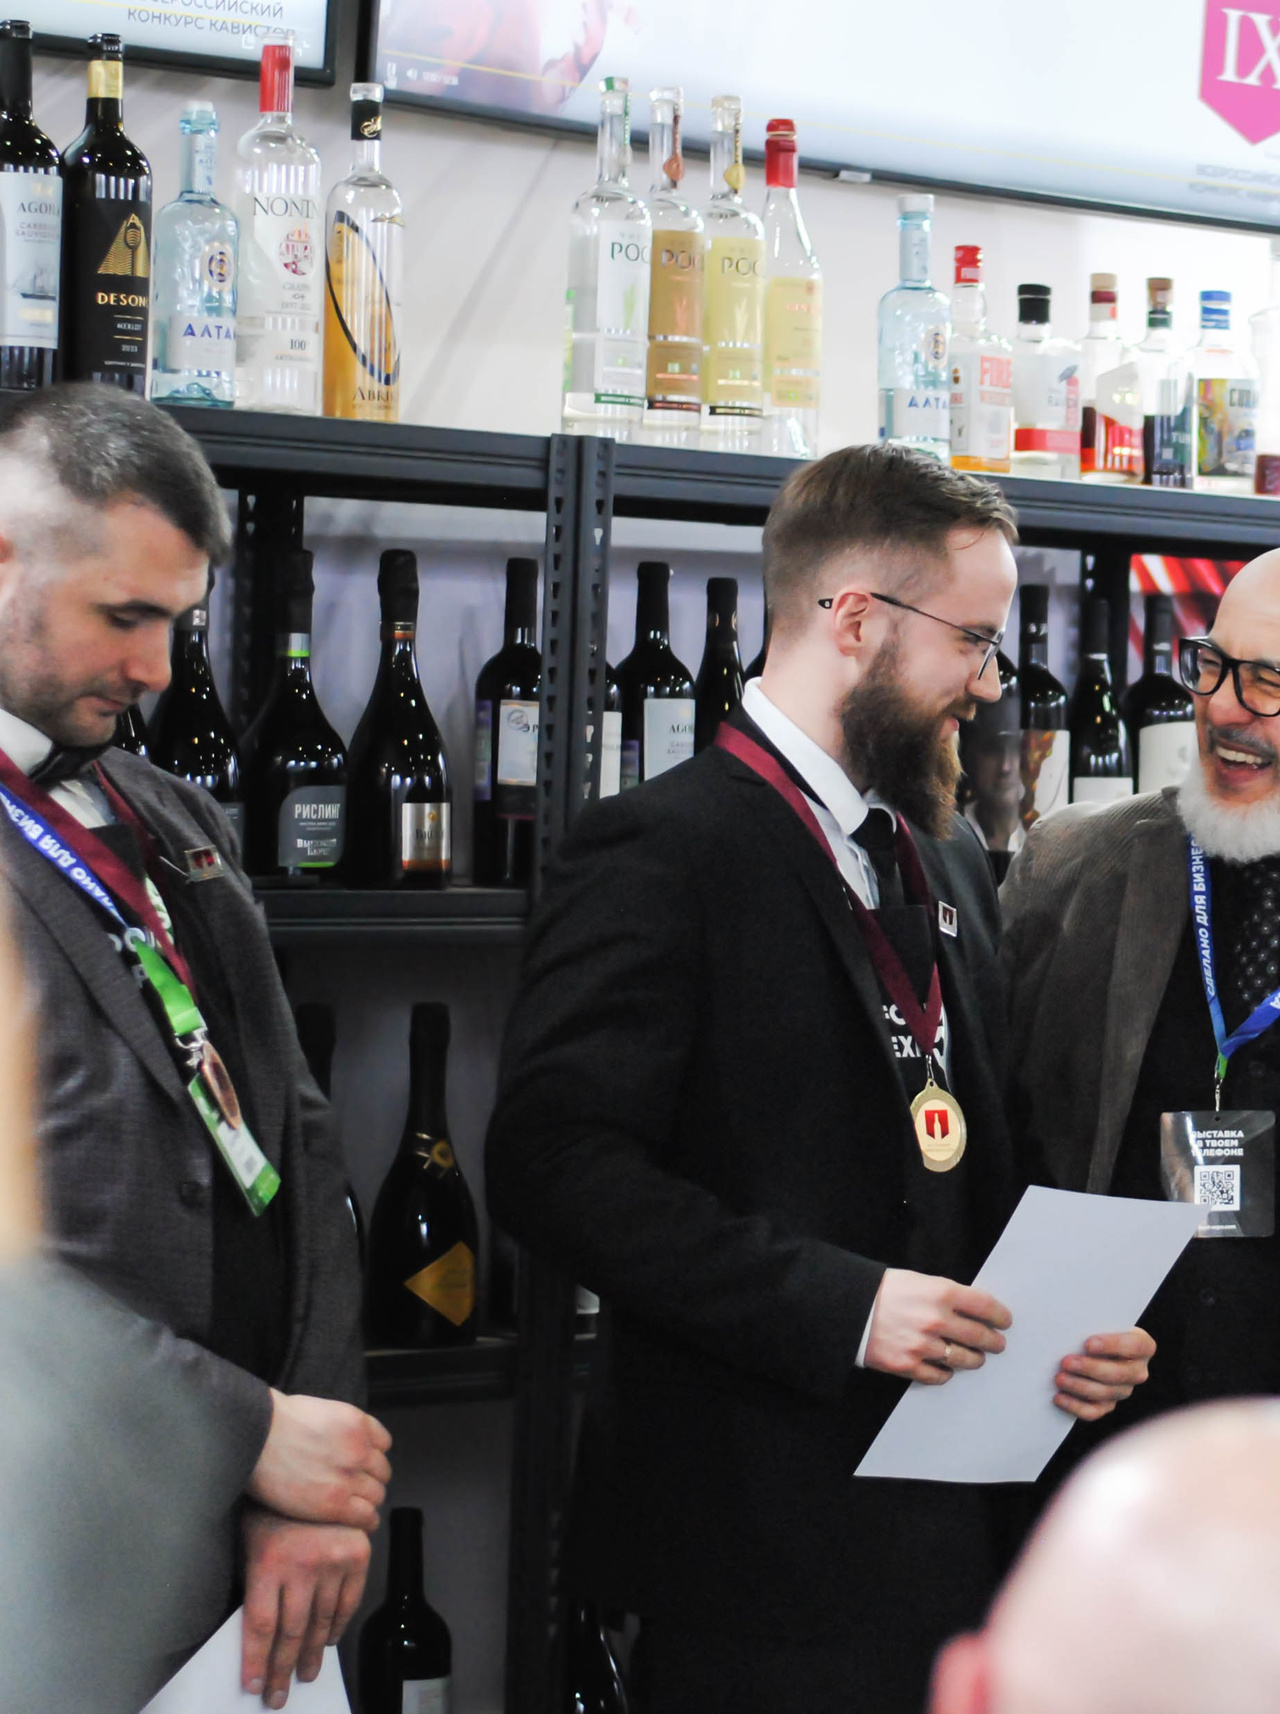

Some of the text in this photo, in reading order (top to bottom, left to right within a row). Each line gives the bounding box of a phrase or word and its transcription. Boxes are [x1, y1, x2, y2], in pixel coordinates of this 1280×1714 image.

[127, 7, 205, 31] КОНКУРС
[96, 291, 148, 307] DESON
[295, 803, 341, 819] РИСЛИНГ
[39, 834, 77, 868] ДЛЯ
[1194, 894, 1209, 926] ДЛЯ
[1199, 928, 1216, 998] СДЕЛАНО
[1192, 1148, 1244, 1156] ТЛЕФОНЕ
[1205, 1139, 1239, 1148] ТВОЕМ
